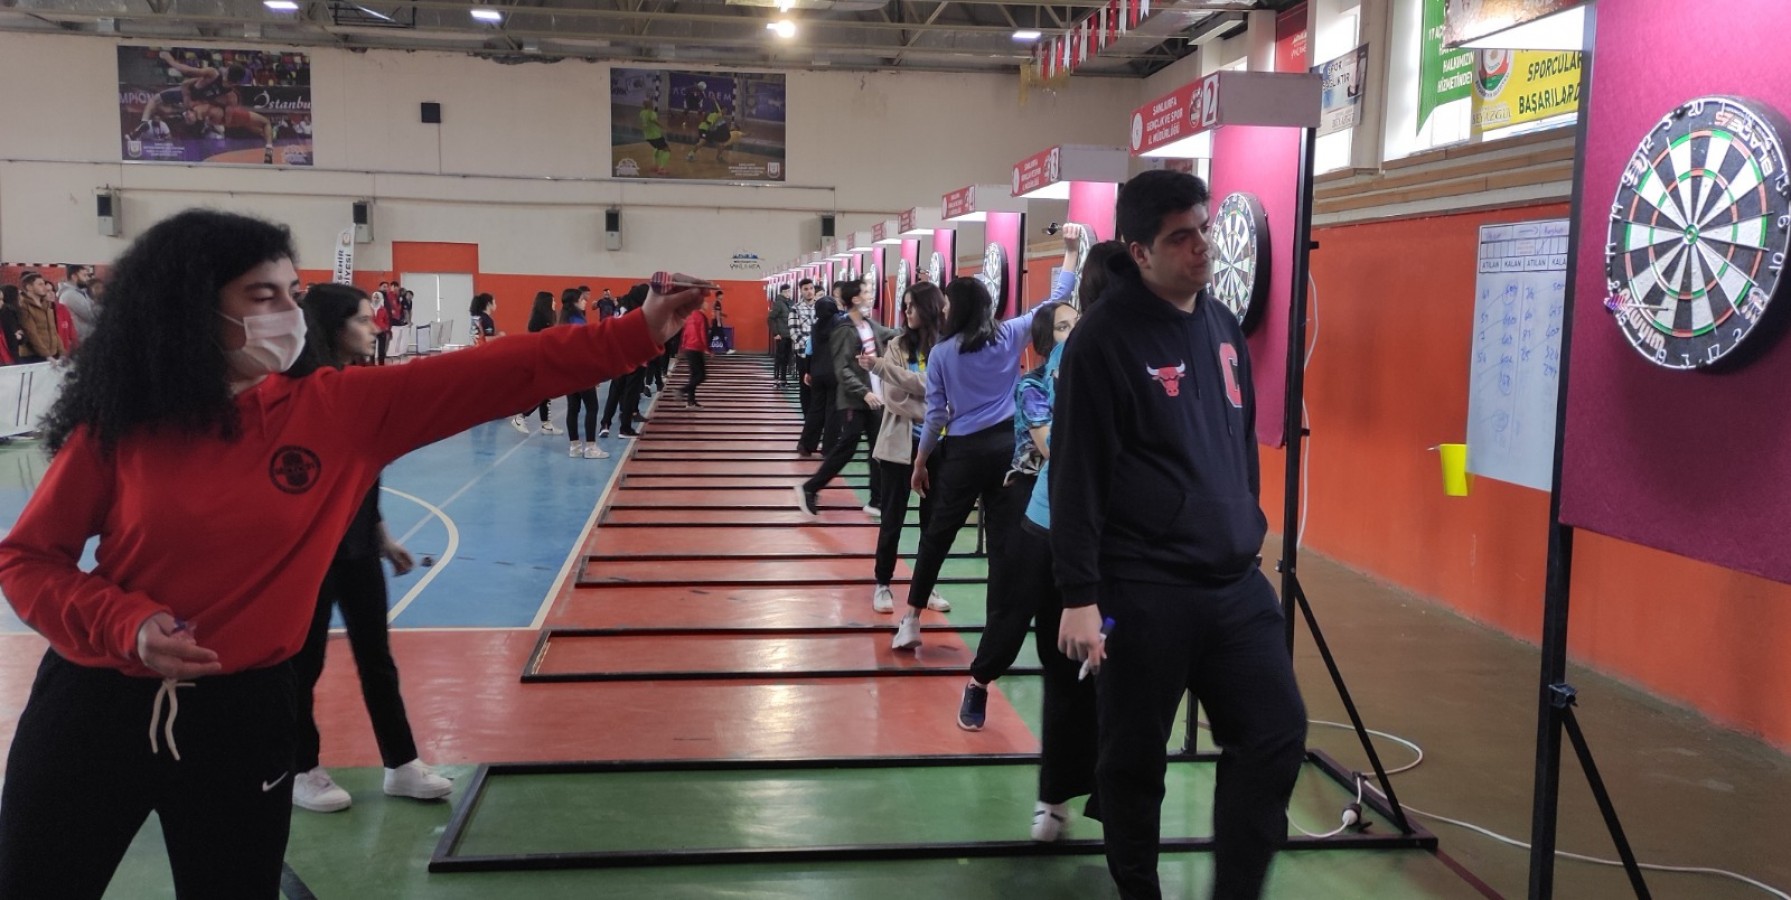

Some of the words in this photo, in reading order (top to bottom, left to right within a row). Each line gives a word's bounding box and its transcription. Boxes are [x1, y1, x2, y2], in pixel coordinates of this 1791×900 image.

[1205, 80, 1215, 123] 2
[1684, 101, 1704, 117] 20
[1219, 342, 1242, 408] C
